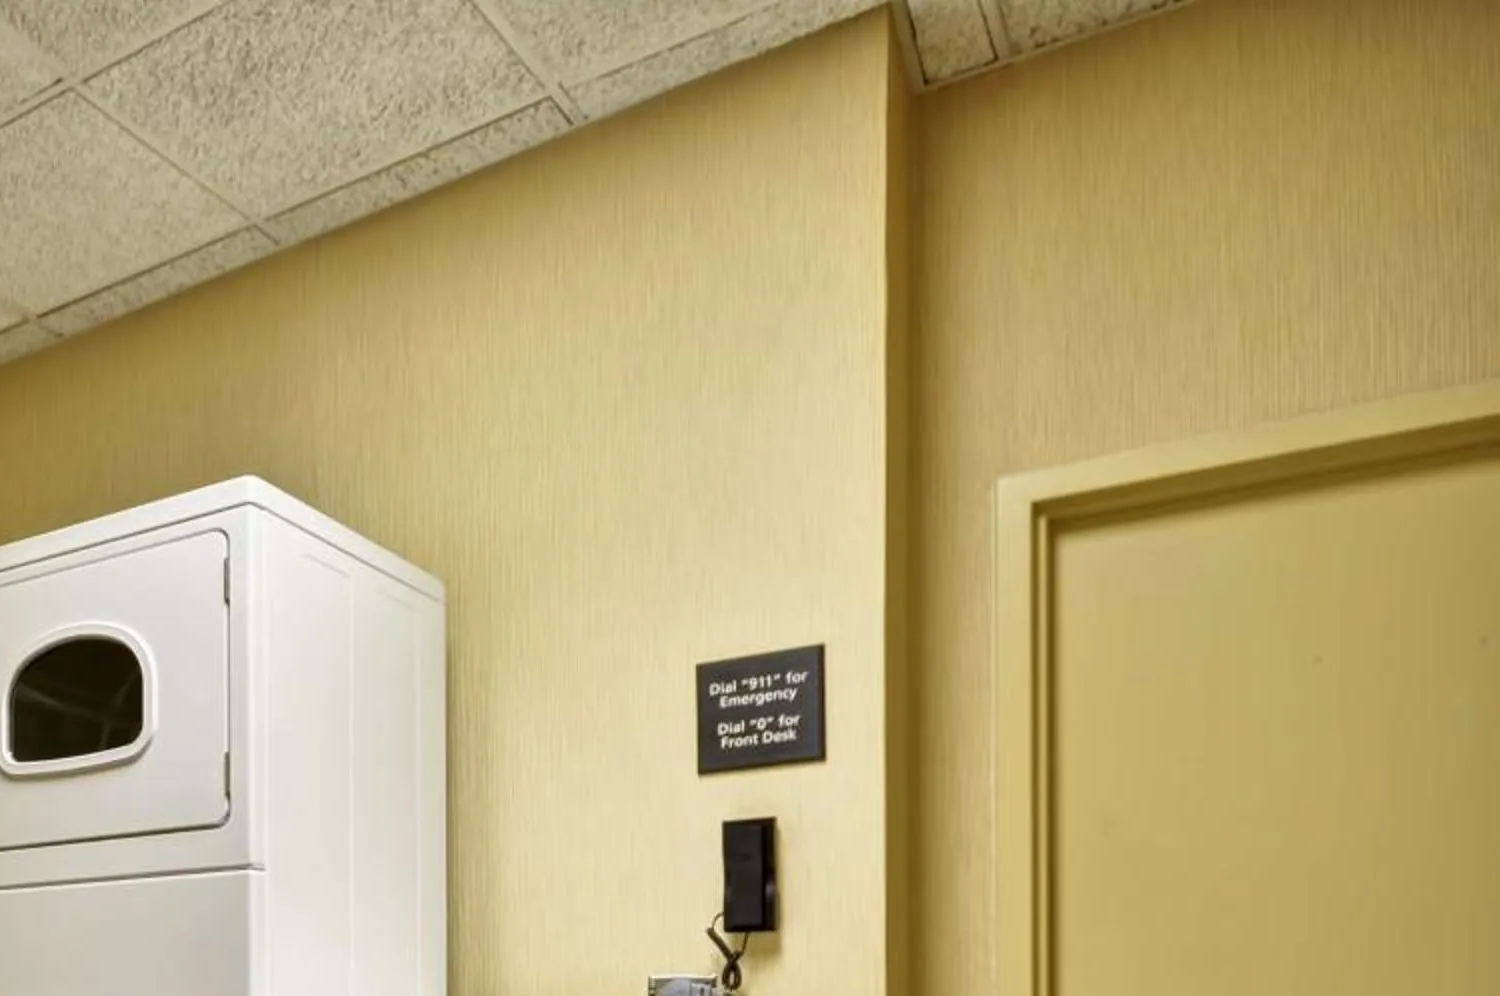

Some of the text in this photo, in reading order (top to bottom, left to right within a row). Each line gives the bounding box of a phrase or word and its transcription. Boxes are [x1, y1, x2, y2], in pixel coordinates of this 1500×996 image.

[708, 680, 737, 697] Dial
[785, 670, 809, 685] for
[719, 687, 799, 709] Emergency
[717, 719, 745, 736] Dial
[779, 713, 801, 728] for
[721, 728, 798, 749] Front Desk
